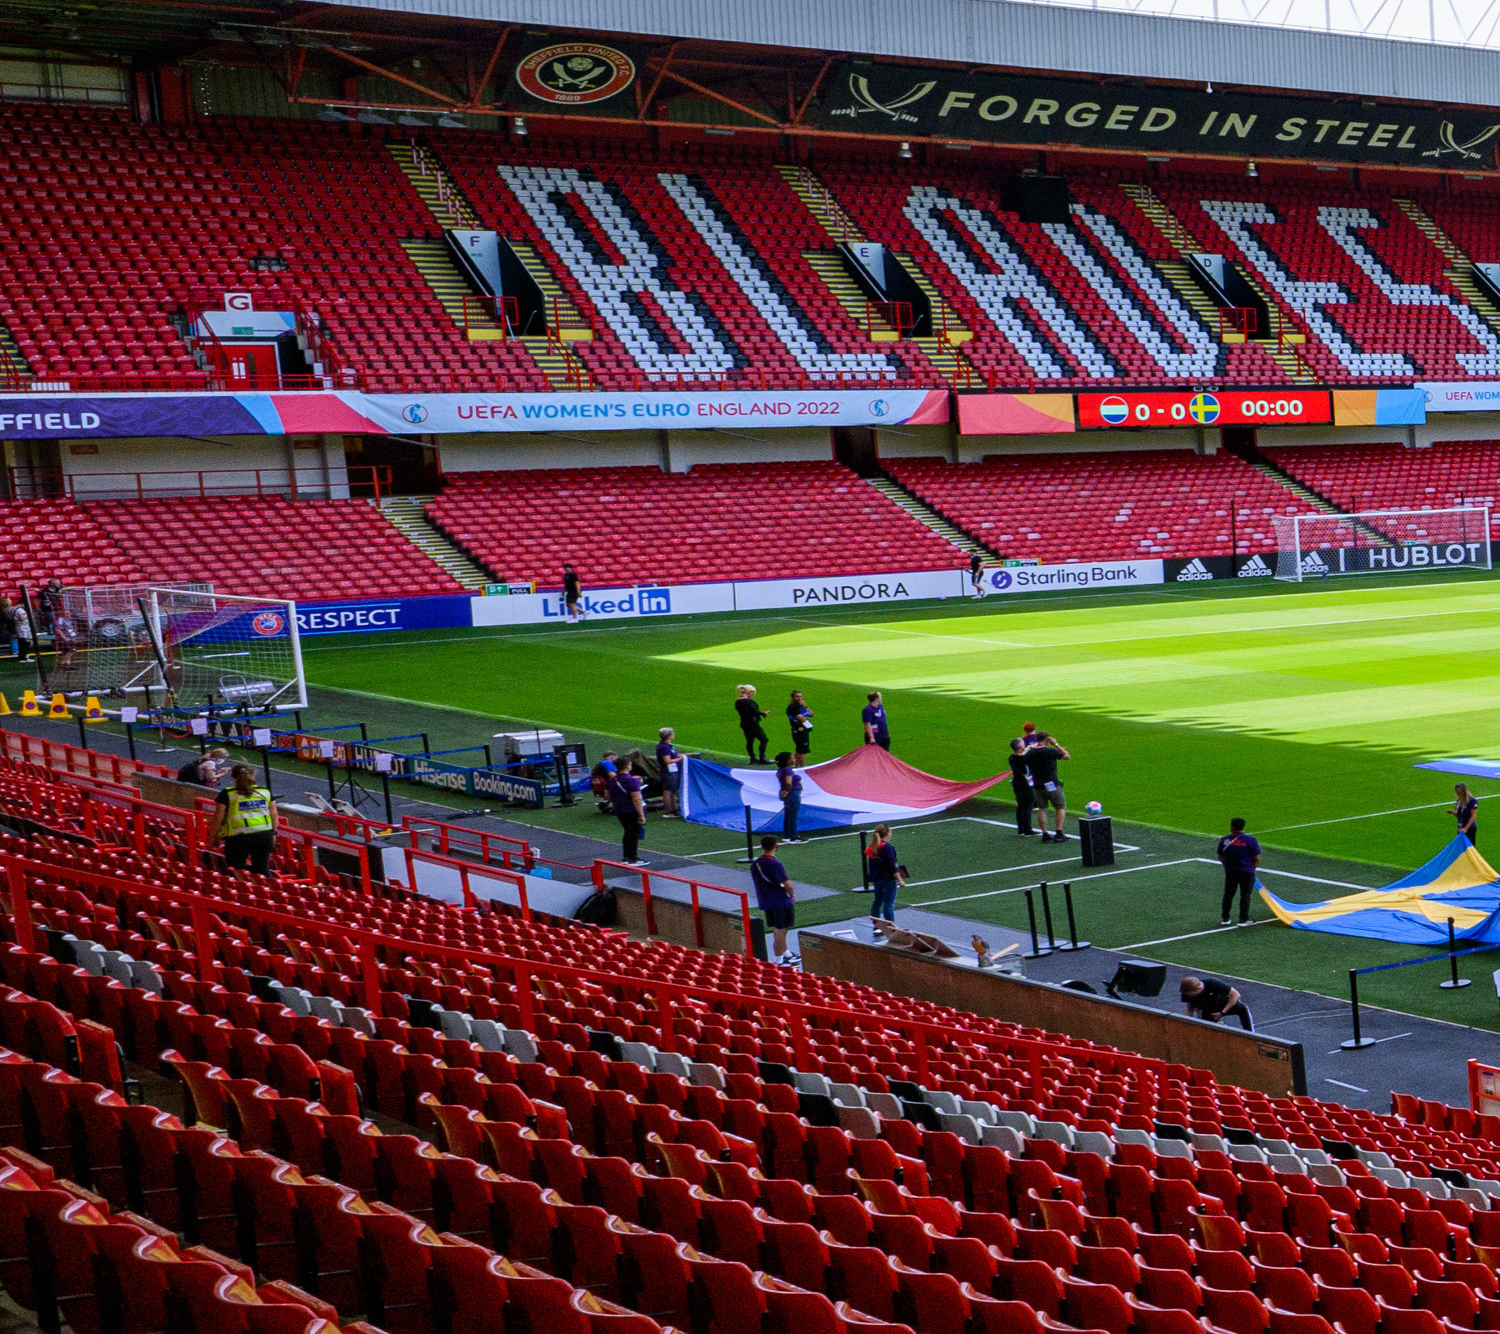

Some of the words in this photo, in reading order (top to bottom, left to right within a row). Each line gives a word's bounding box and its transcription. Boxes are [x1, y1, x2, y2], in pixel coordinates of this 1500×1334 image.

[524, 46, 583, 70] SHEFFIELD
[587, 47, 625, 66] UNITED
[938, 91, 1177, 132] FORGED
[1199, 111, 1257, 138] IN
[1275, 117, 1416, 149] STEEL
[469, 235, 480, 247] F
[860, 247, 870, 258] E
[1204, 259, 1212, 267] D
[227, 295, 251, 310] G
[1445, 391, 1474, 402] UEFA
[457, 404, 518, 420] UEFA
[521, 403, 627, 419] WOMEN'S
[632, 402, 691, 418] EURO
[697, 402, 792, 417] ENGLAND
[797, 401, 840, 415] 2022
[1136, 404, 1151, 421] 0
[1171, 403, 1186, 420] 0
[1241, 400, 1303, 417] 00:00
[1370, 543, 1480, 569] HUBLOT
[1017, 569, 1090, 592] Starling
[1092, 565, 1138, 583] Bank
[1176, 568, 1213, 582] adidas
[1237, 565, 1273, 578] adidas
[793, 579, 910, 605] PANDORA
[296, 607, 400, 631] RESPECT
[473, 769, 536, 801] Booking.com
